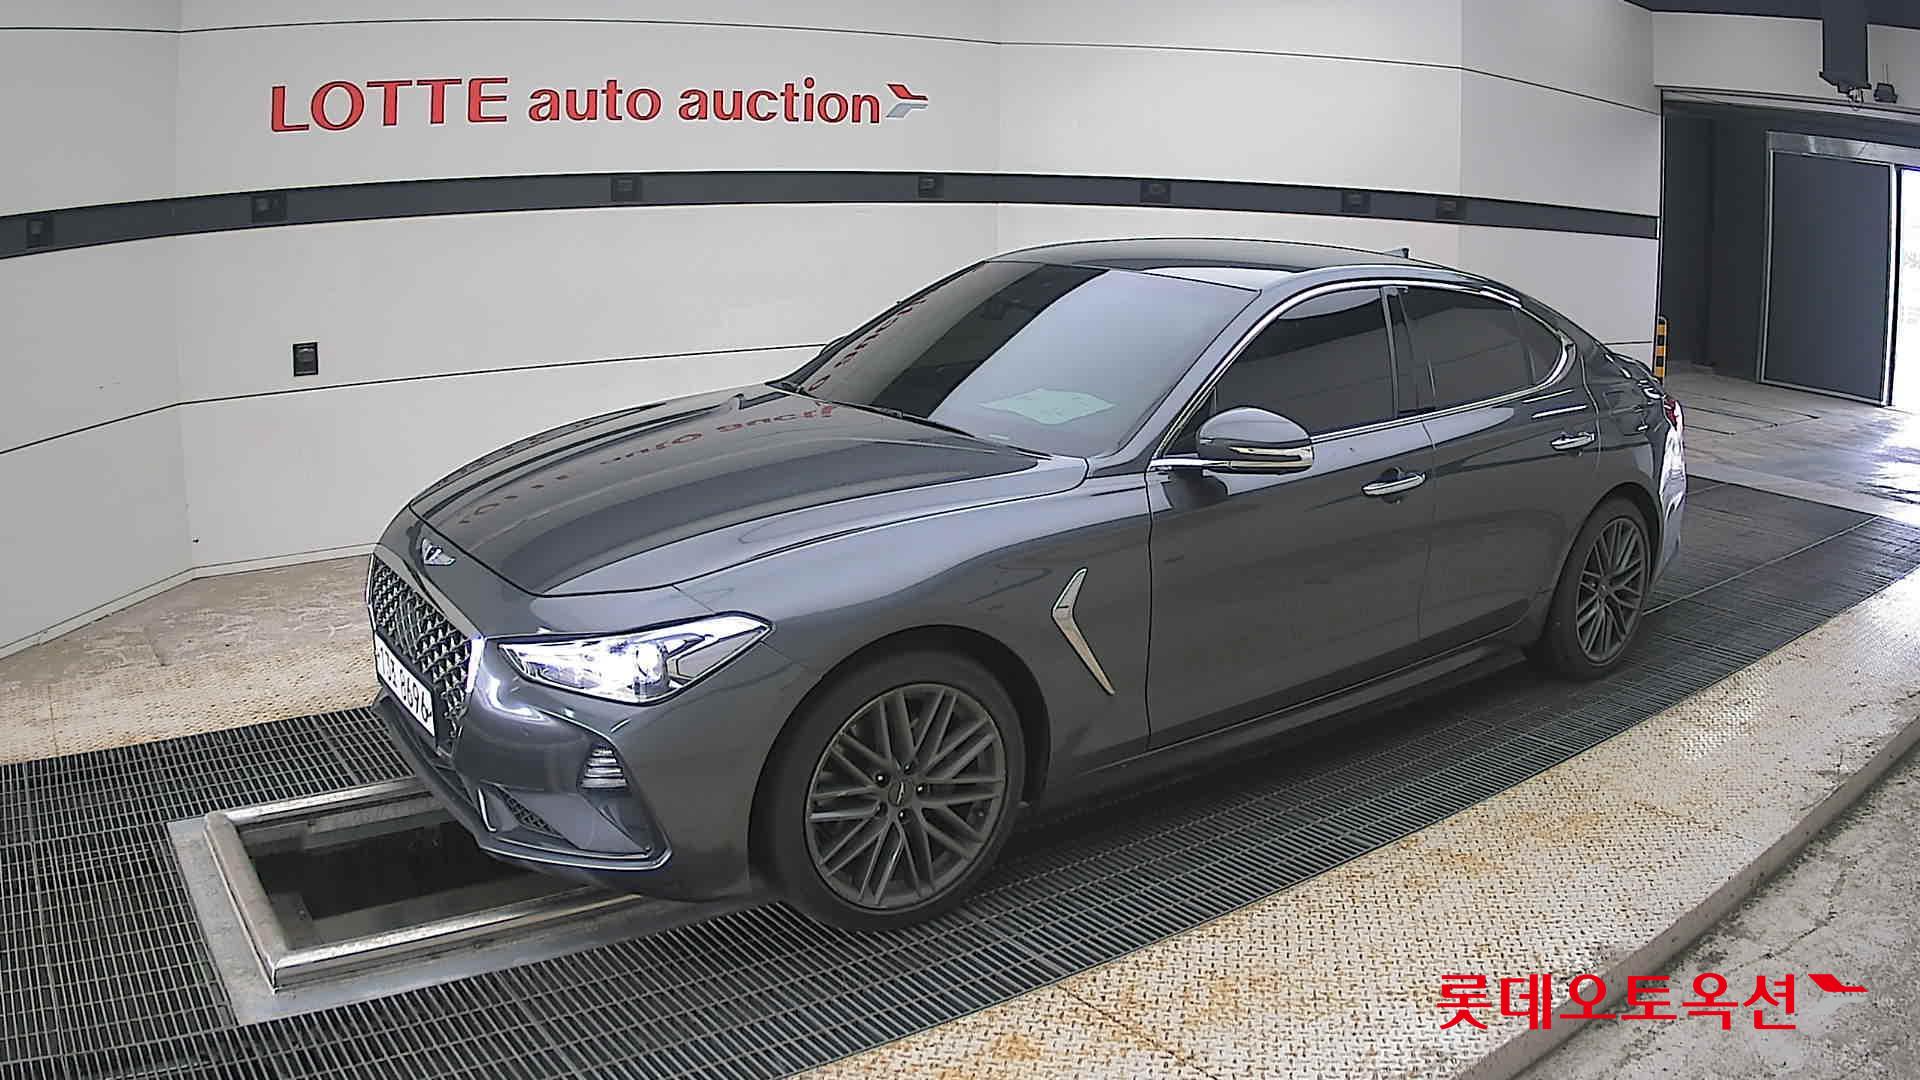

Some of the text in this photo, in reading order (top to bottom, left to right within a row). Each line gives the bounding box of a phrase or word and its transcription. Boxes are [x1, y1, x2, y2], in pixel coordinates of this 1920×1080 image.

[271, 76, 881, 133] LOTTE auto auction
